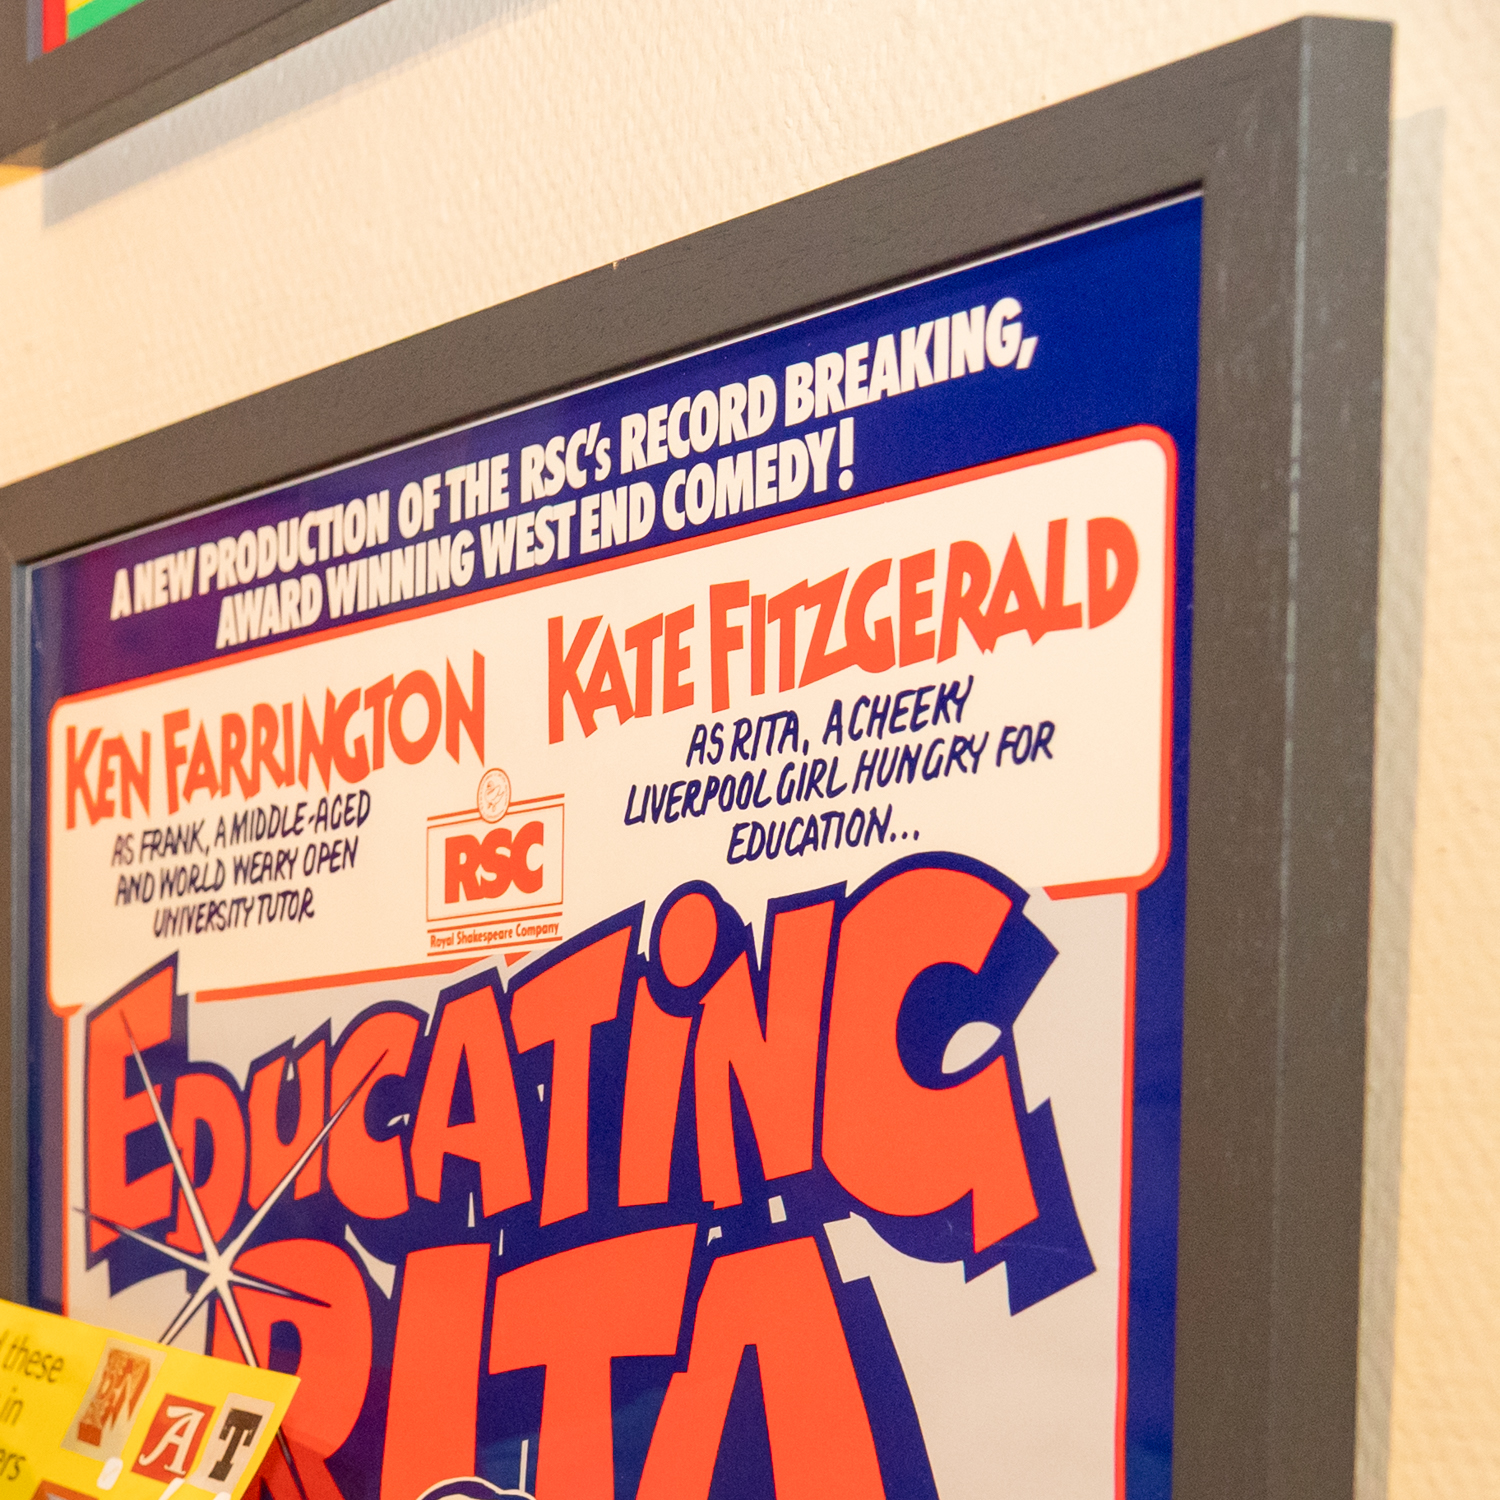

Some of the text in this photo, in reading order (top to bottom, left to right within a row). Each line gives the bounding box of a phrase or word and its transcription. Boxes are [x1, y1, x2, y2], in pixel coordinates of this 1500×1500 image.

[110, 297, 1038, 620] A NEW PRODUCTION OF THE RSC's RECORD BREAKING,
[215, 417, 855, 649] AWARD WINNING WEST END COMEDY!
[548, 516, 1139, 745] KATE FITZGERALD
[65, 648, 485, 831] KEN FARRINGTON
[686, 675, 975, 768] AS RITA, A CHEEKY
[624, 720, 1056, 826] LIVERPOOL GIRL HUNGRY FOR
[111, 789, 371, 867] AS FRANK, A MIDDLE-AGED
[445, 821, 544, 904] RSC
[726, 803, 921, 865] EDUCATION...
[115, 836, 359, 906] AND WORLD WEARY OPEN
[154, 887, 315, 938] UNIVERSITY TUTOR
[430, 922, 559, 949] Royal Shakespeare Company
[84, 855, 1075, 1285] EDUCATING
[2, 1336, 64, 1383] these
[138, 1404, 263, 1482] A T
